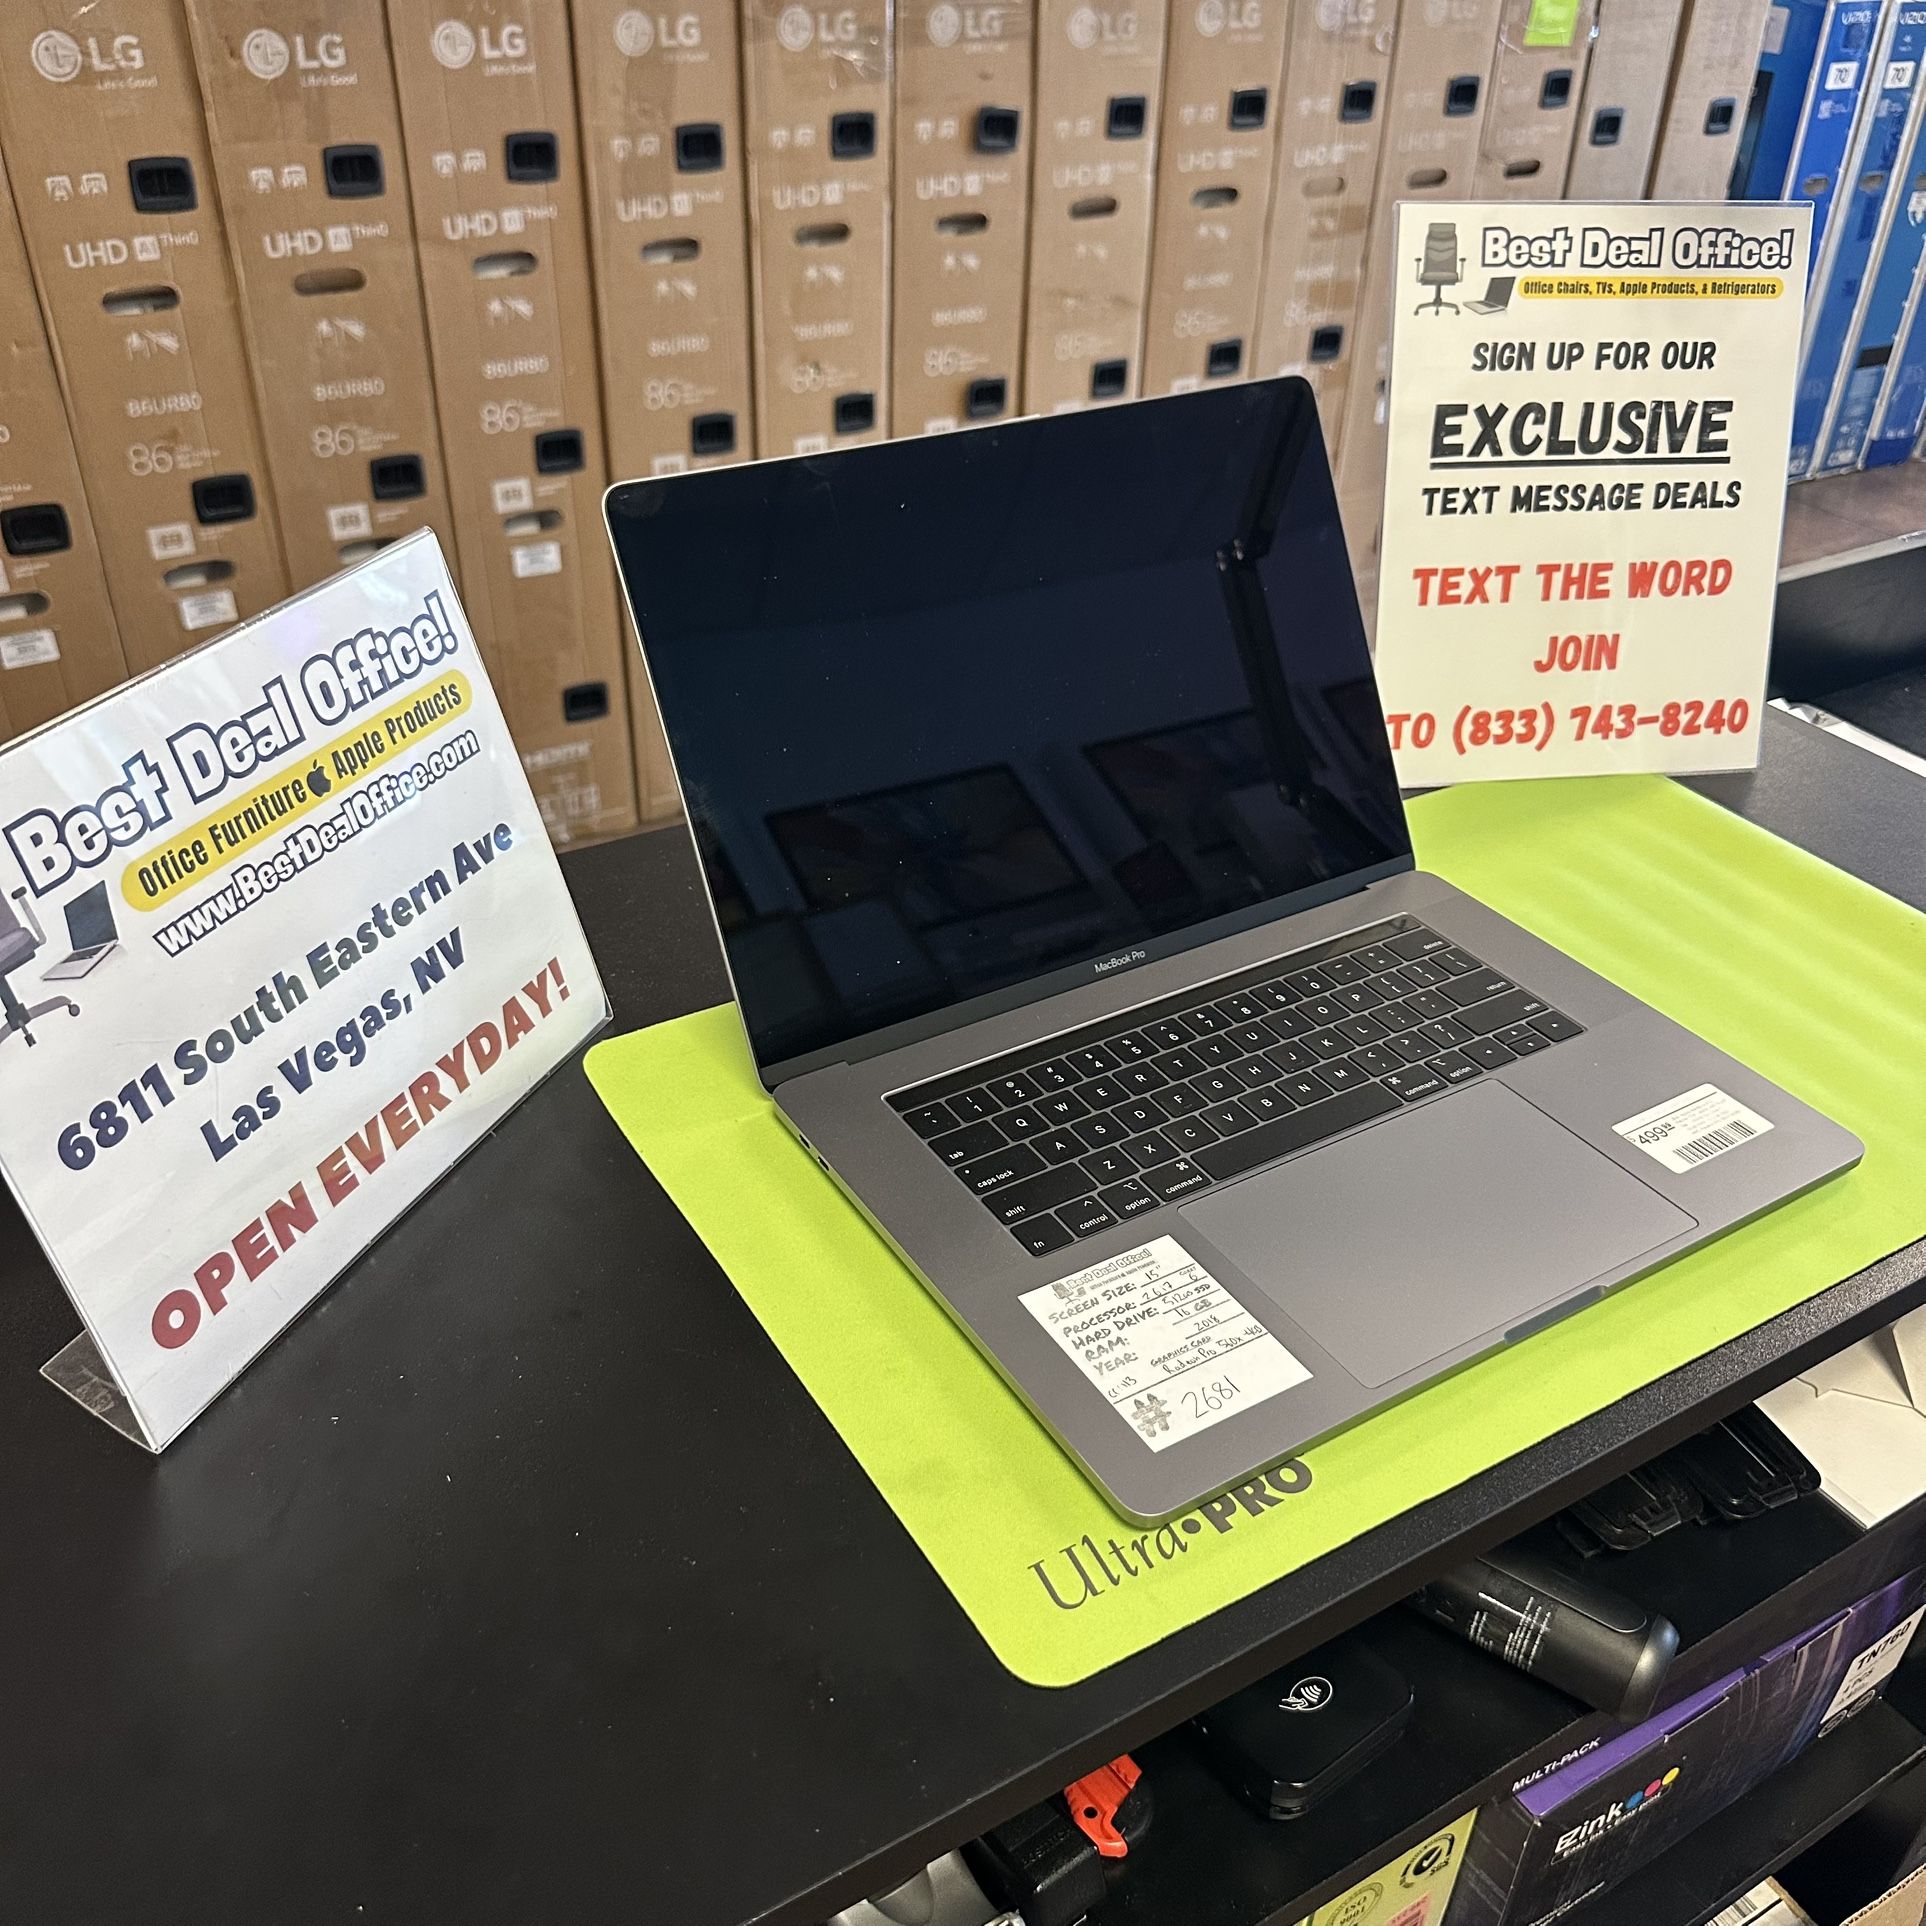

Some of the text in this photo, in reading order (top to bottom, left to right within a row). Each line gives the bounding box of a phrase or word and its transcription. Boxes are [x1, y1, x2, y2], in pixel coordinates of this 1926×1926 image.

[818, 11, 858, 42] LG
[963, 8, 1001, 39] LG
[1101, 11, 1139, 42] LG
[1228, 1, 1262, 29] LG
[480, 24, 528, 60] LG
[659, 15, 700, 48] LG
[87, 34, 145, 72] LG
[295, 34, 347, 69] LG
[772, 184, 821, 210] UHD
[616, 196, 669, 223] UHD
[442, 212, 497, 240] UHD
[64, 238, 129, 269] UHD
[263, 229, 323, 259] UHD
[1481, 226, 1795, 270] Best Deal Office!
[1523, 281, 1554, 296] Office
[1556, 281, 1594, 297] Chairs,
[1596, 281, 1617, 297] TVs,
[1619, 281, 1647, 298] Apple
[1650, 280, 1699, 297] Products,
[1711, 280, 1777, 298] Refrigerators
[1471, 341, 1717, 371] SIGN UP FOR OUR
[480, 400, 520, 434] 86
[312, 424, 355, 458] 86
[1430, 400, 1734, 461] EXCLUSIVE
[128, 441, 174, 476] 86
[1421, 480, 1742, 516] TEXT MESSAGE DEALS
[1413, 558, 1733, 607] TEXT THE WORD
[1533, 633, 1620, 674] JOIN
[1386, 698, 1749, 756] TO (833) 743-8240
[3, 589, 459, 899] Best Deal Office!
[137, 682, 463, 898] Office Furniture Apple Products
[153, 729, 481, 958] www.BestDealOffice.com
[1423, 939, 1444, 950] delete
[1094, 950, 1146, 973] MacBook Pro
[57, 821, 514, 1171] 6811 South Eastern Ave
[1351, 993, 1361, 1002] P
[1486, 980, 1507, 992] return
[1523, 1001, 1540, 1012] shift
[1246, 1032, 1258, 1041] U
[1356, 1026, 1368, 1034] L
[199, 926, 467, 1163] Las Vegas, NV
[1210, 1045, 1221, 1054] Y
[1321, 1038, 1334, 1047] K
[1172, 1059, 1184, 1068] T
[1288, 1052, 1297, 1060] J
[1134, 1073, 1147, 1083] R
[1249, 1065, 1262, 1075] H
[1334, 1069, 1349, 1079] M
[1449, 1065, 1473, 1078] option
[1096, 1087, 1108, 1097] E
[1211, 1080, 1224, 1089] G
[1297, 1083, 1312, 1093] N
[1405, 1079, 1439, 1096] command
[1054, 1102, 1069, 1112] W
[1173, 1095, 1183, 1104] F
[1260, 1098, 1273, 1107] B
[1015, 1118, 1029, 1128] Q
[1133, 1109, 1146, 1119] D
[1222, 1113, 1234, 1122] V
[1094, 1124, 1106, 1134] S
[1184, 1128, 1196, 1137] C
[151, 956, 572, 1351] OPEN EVERYDAY!
[949, 1150, 964, 1160] tab
[1054, 1140, 1066, 1150] A
[1143, 1144, 1157, 1154] X
[1102, 1160, 1116, 1170] Z
[977, 1169, 1014, 1189] caps lock
[1165, 1174, 1203, 1194] command
[1005, 1204, 1026, 1217] shift
[1125, 1196, 1151, 1211] option
[1079, 1213, 1109, 1230] control
[1033, 1239, 1045, 1248] fn
[1048, 1297, 1100, 1325] SCREEN
[1101, 1281, 1137, 1301] SIZE:
[1062, 1301, 1137, 1338] PROCESSOR:
[1071, 1327, 1111, 1350] HARD
[1113, 1306, 1160, 1331] DRIVE:
[1084, 1336, 1130, 1362] RAM:
[1093, 1314, 1220, 1376] YEAR: 2018
[1150, 1335, 1212, 1368] GRAPHICS CARD
[1180, 1375, 1241, 1419] 2681
[1857, 1621, 1912, 1670] TN760
[1512, 1737, 1601, 1791] MULTI-PACK
[1344, 1895, 1368, 1915] ISO
